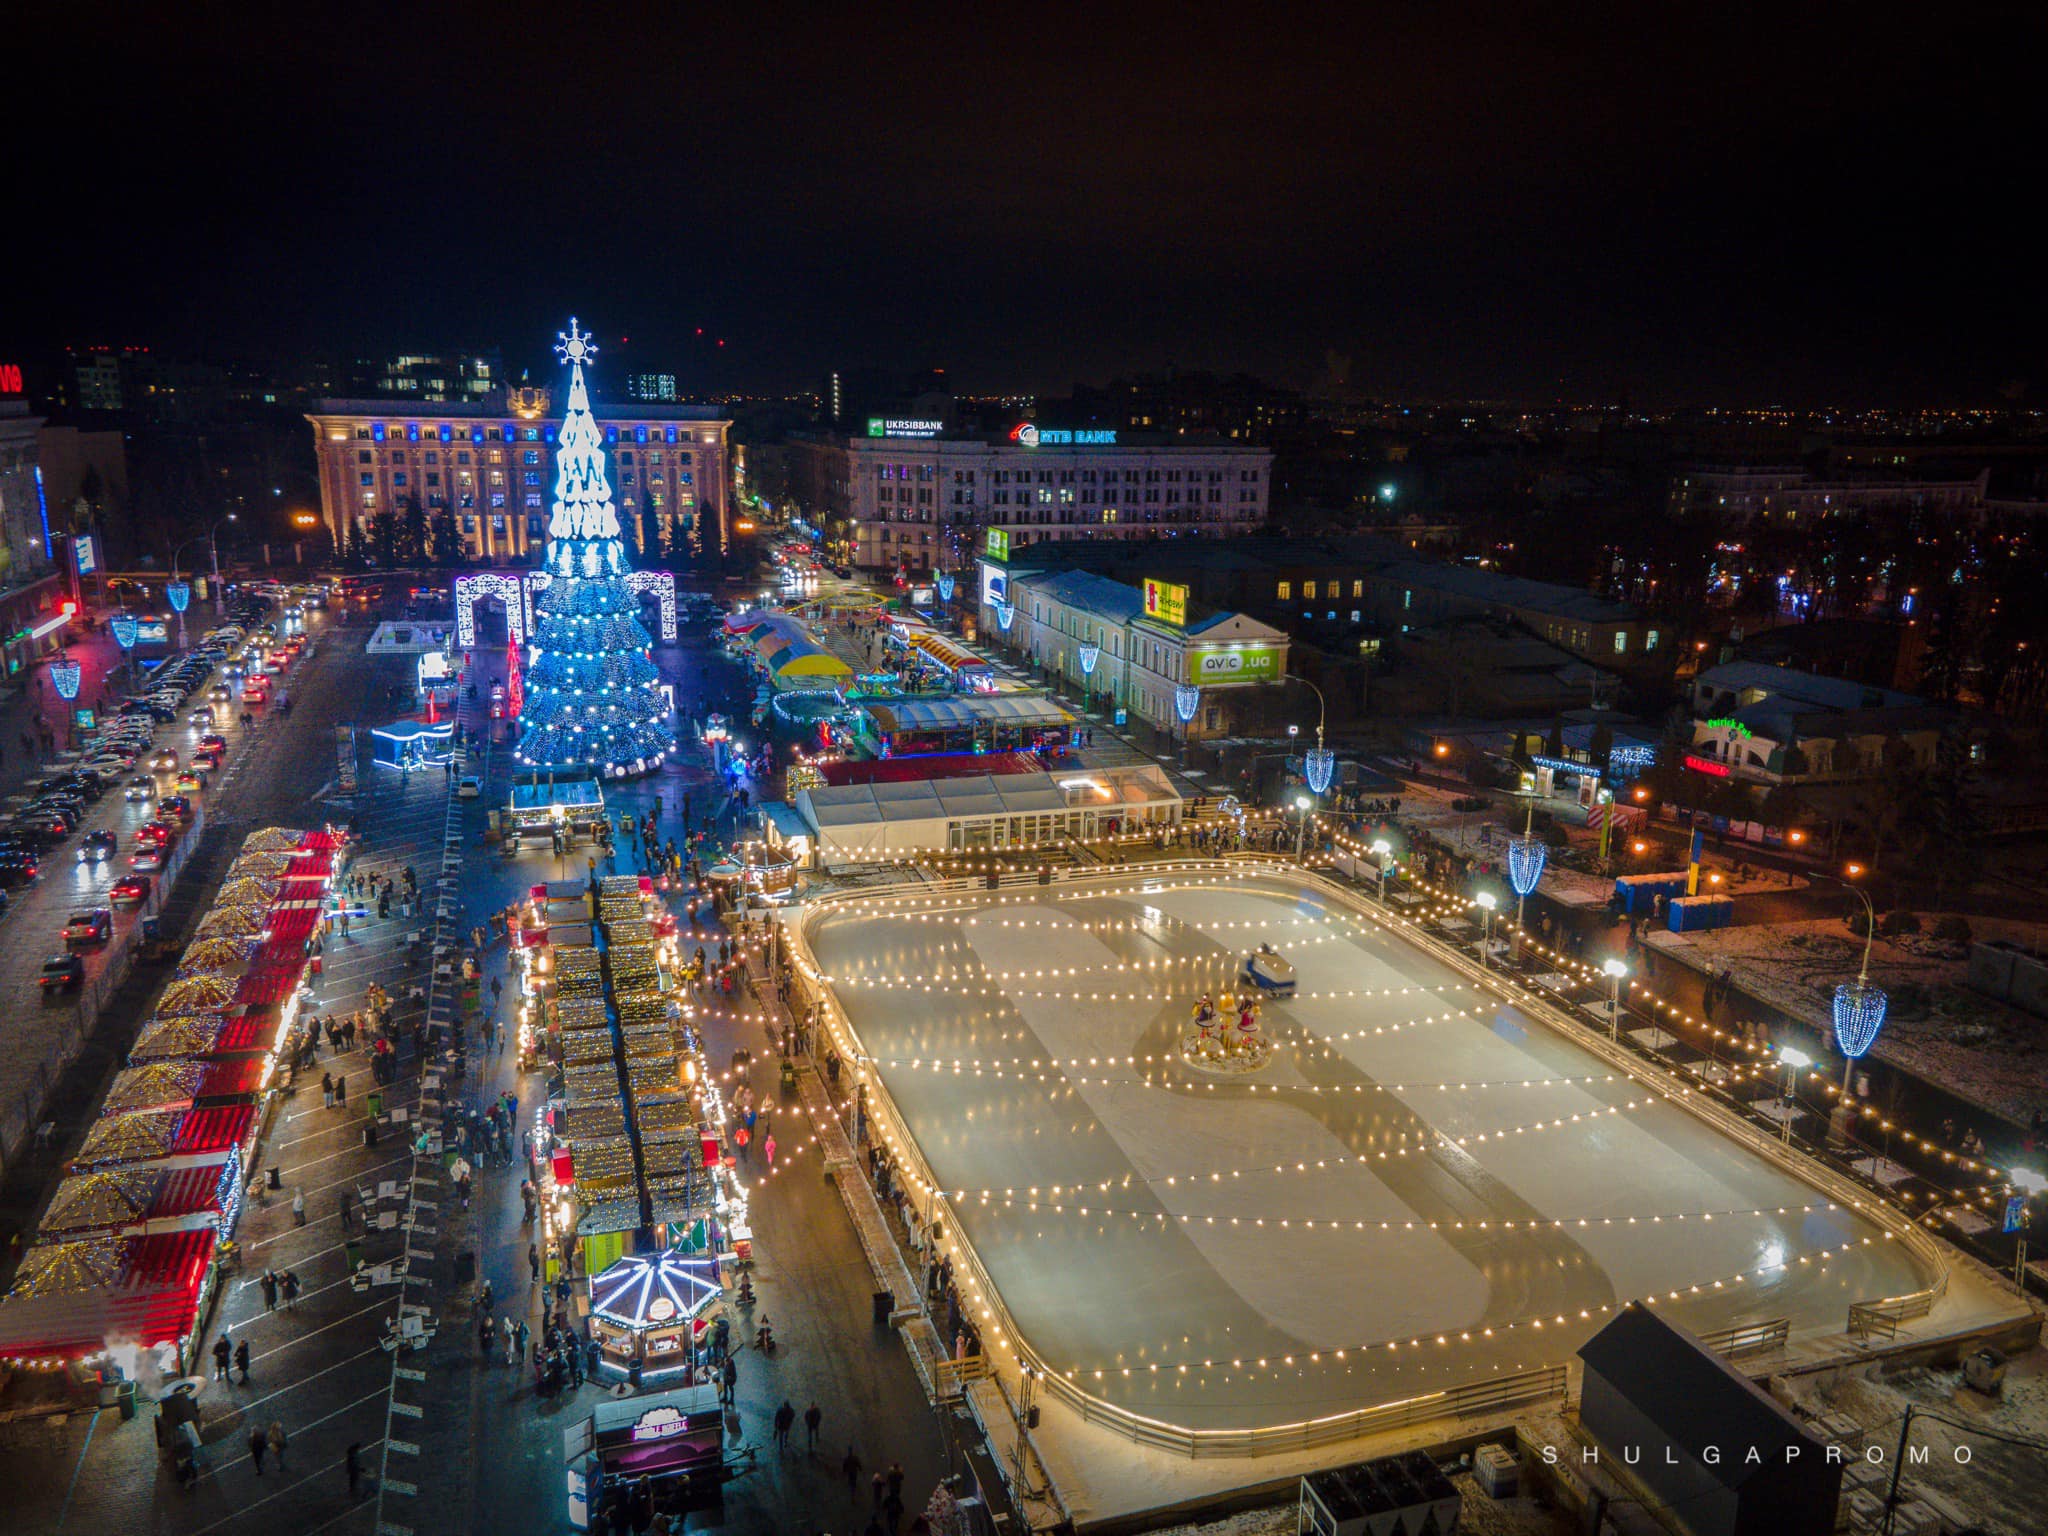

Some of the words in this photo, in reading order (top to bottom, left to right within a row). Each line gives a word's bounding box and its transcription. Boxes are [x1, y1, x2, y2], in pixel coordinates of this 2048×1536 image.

[885, 419, 943, 430] UKRSIBBANK
[1040, 430, 1072, 443] MTB
[1075, 430, 1117, 443] BANK
